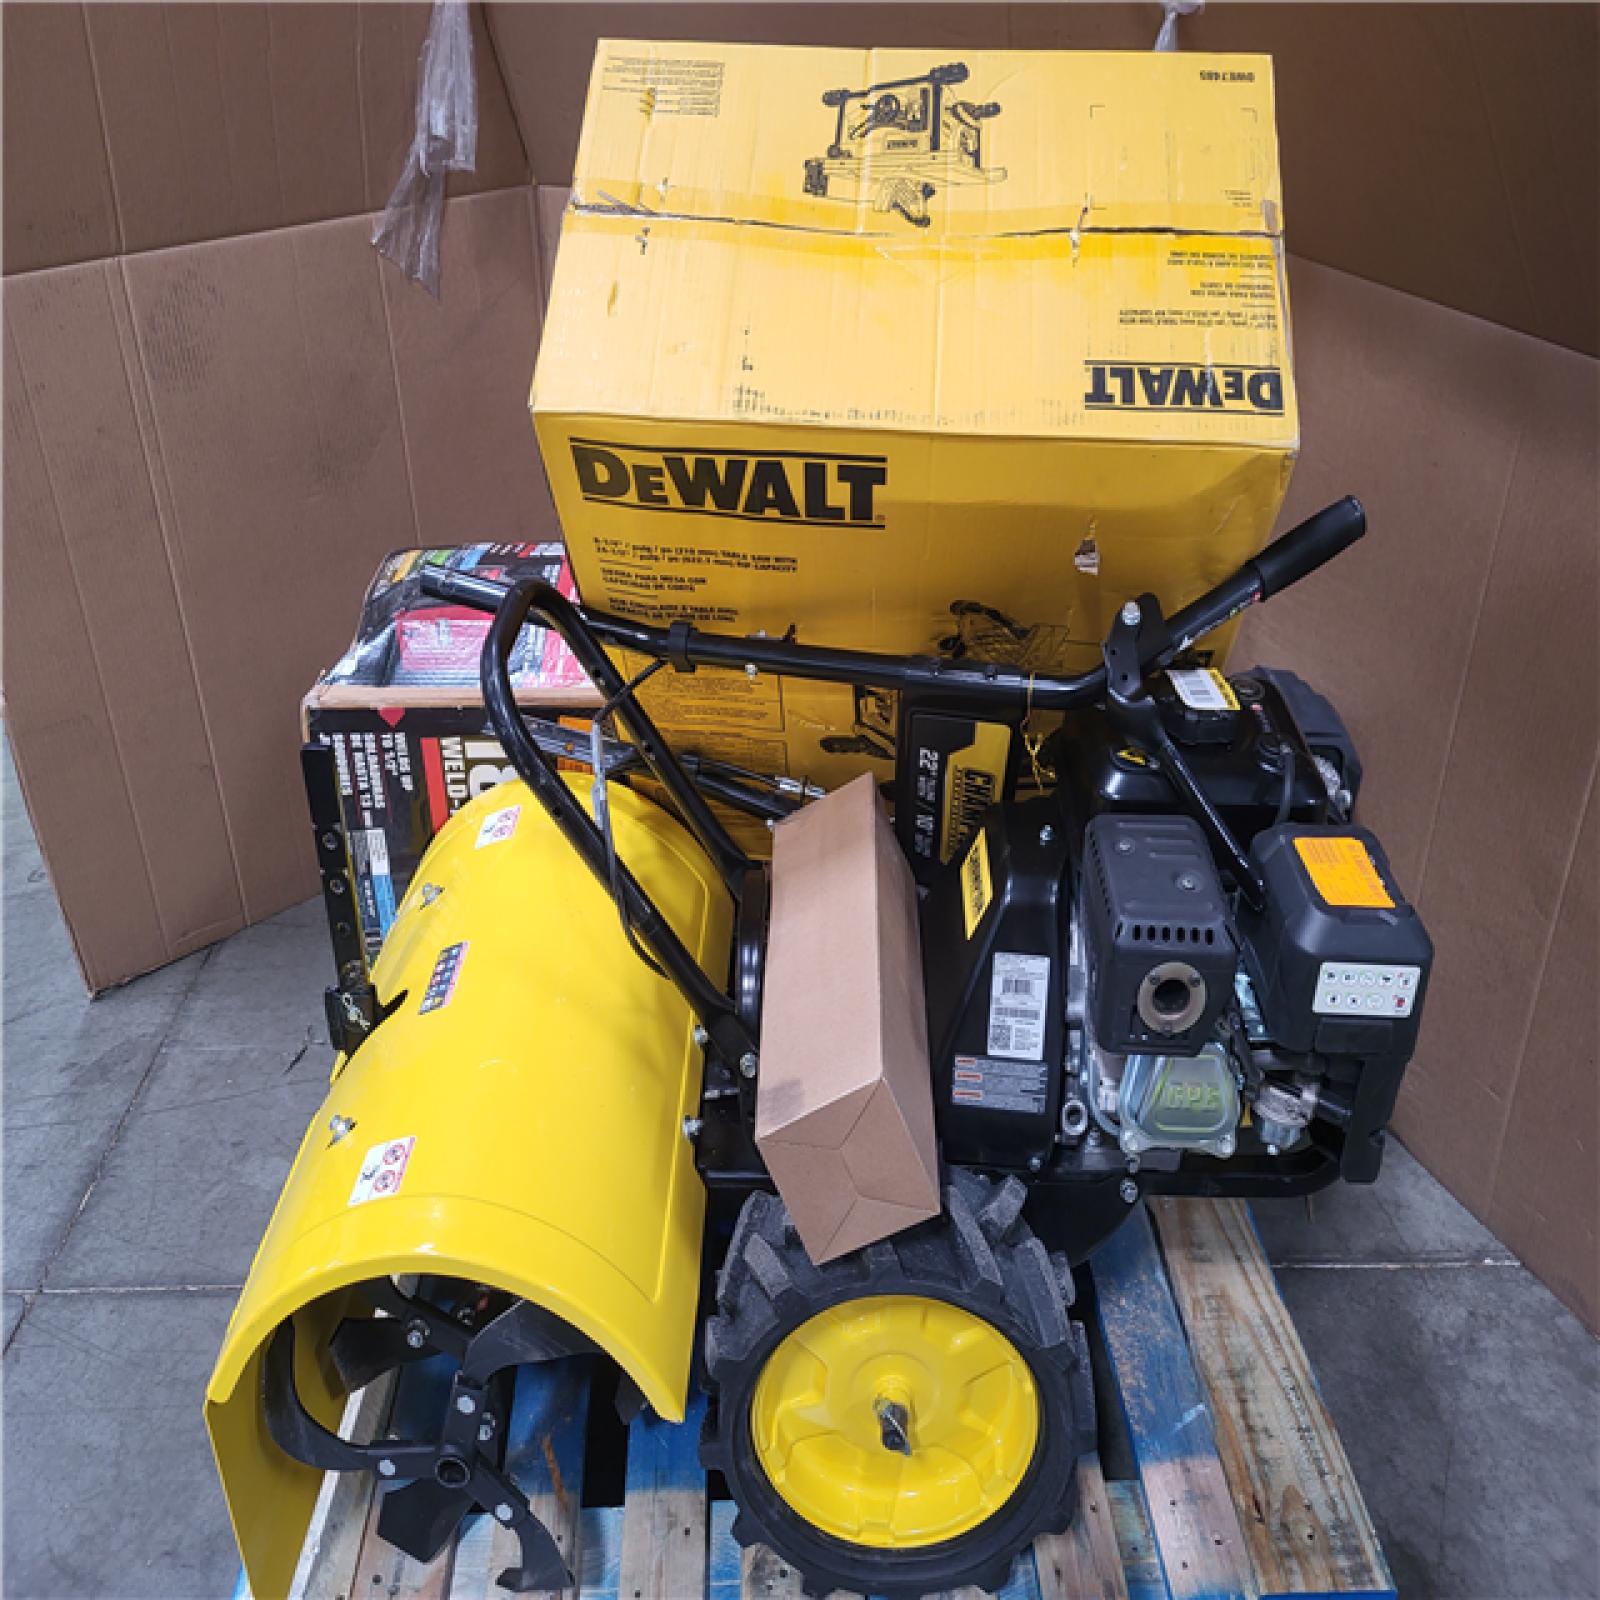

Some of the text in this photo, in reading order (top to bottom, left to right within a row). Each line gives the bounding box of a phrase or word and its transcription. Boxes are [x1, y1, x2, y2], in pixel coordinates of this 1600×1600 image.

[1084, 366, 1283, 410] DeWALT
[571, 445, 888, 522] DeWALT
[350, 731, 364, 748] DE
[380, 731, 394, 748] TO
[394, 731, 414, 791] WELDS UP
[353, 751, 369, 791] HASTA
[364, 731, 386, 809] SOLDADURAS
[439, 736, 468, 817] WELD-
[359, 794, 373, 809] 13
[960, 768, 995, 845] CHAMP
